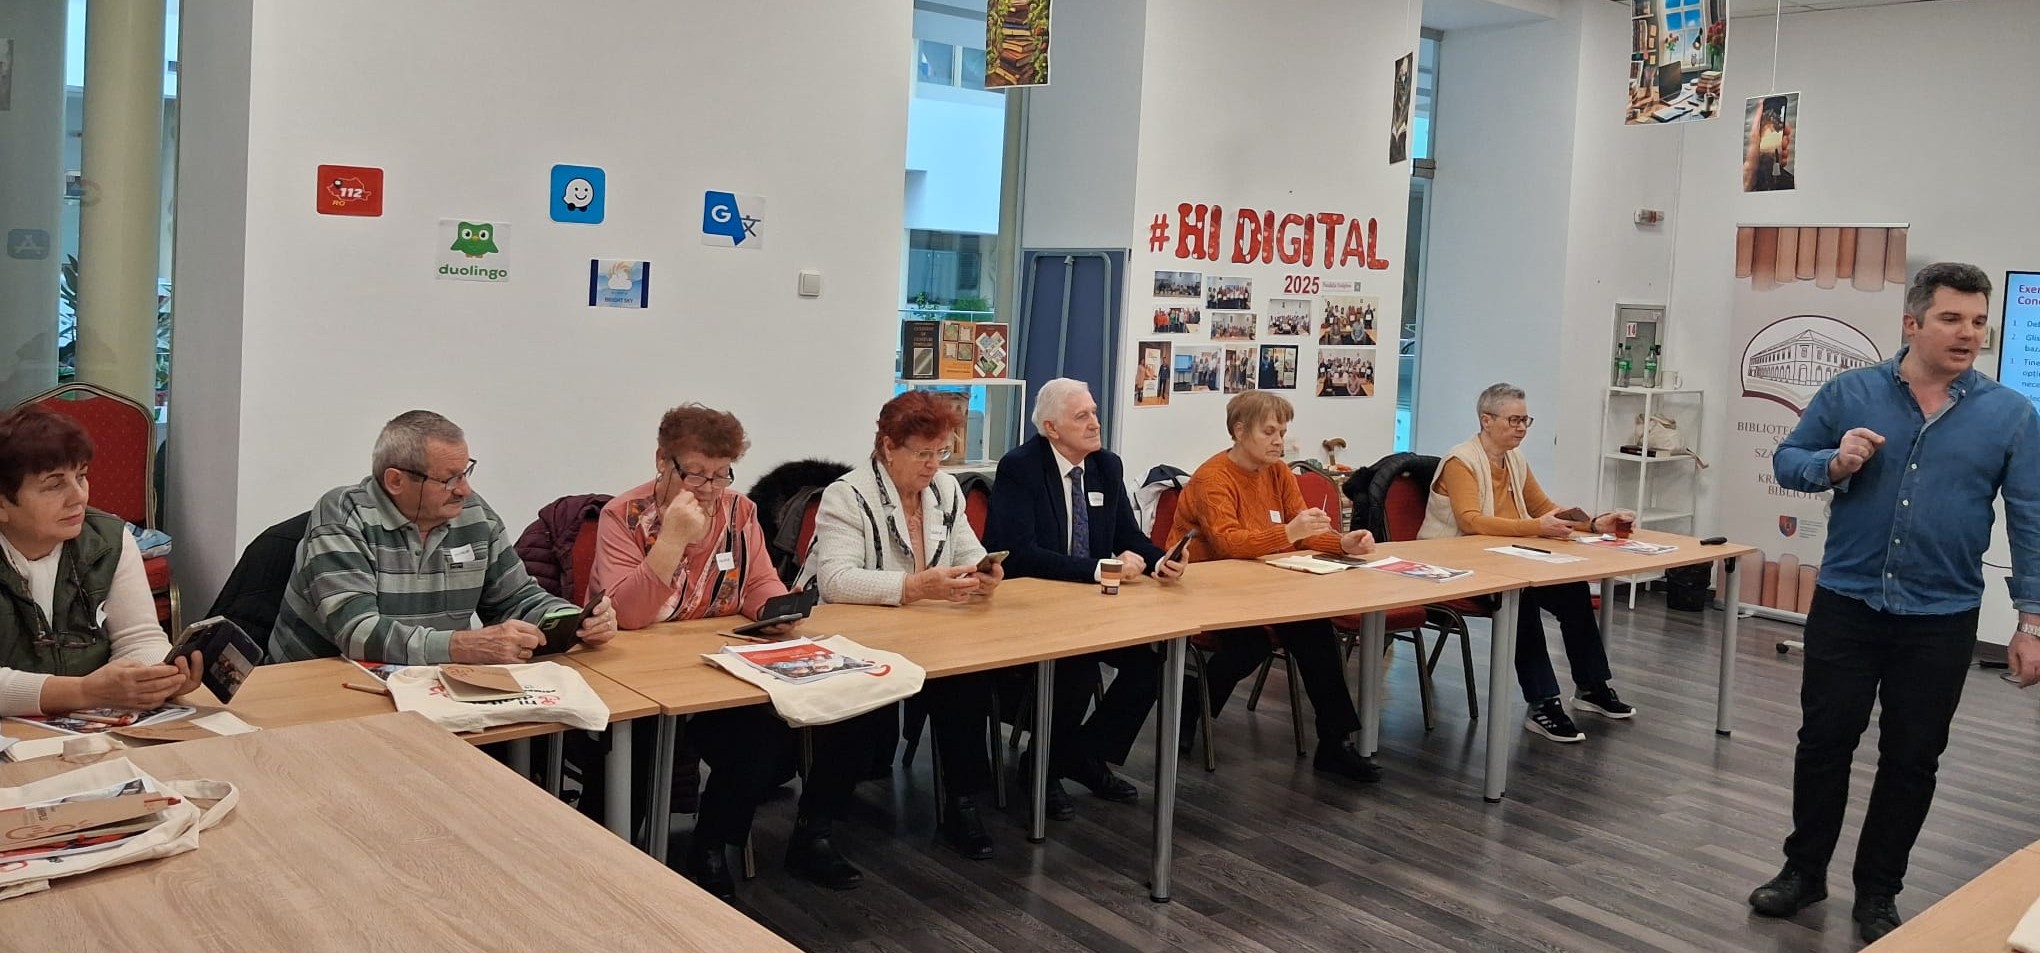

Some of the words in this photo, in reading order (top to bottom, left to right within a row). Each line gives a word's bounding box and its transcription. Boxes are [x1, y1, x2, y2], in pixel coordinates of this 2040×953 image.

[340, 187, 363, 198] 112
[711, 204, 732, 223] G
[1231, 207, 1389, 271] DIGITAL
[439, 263, 507, 280] duolingo
[1284, 274, 1320, 295] 2025
